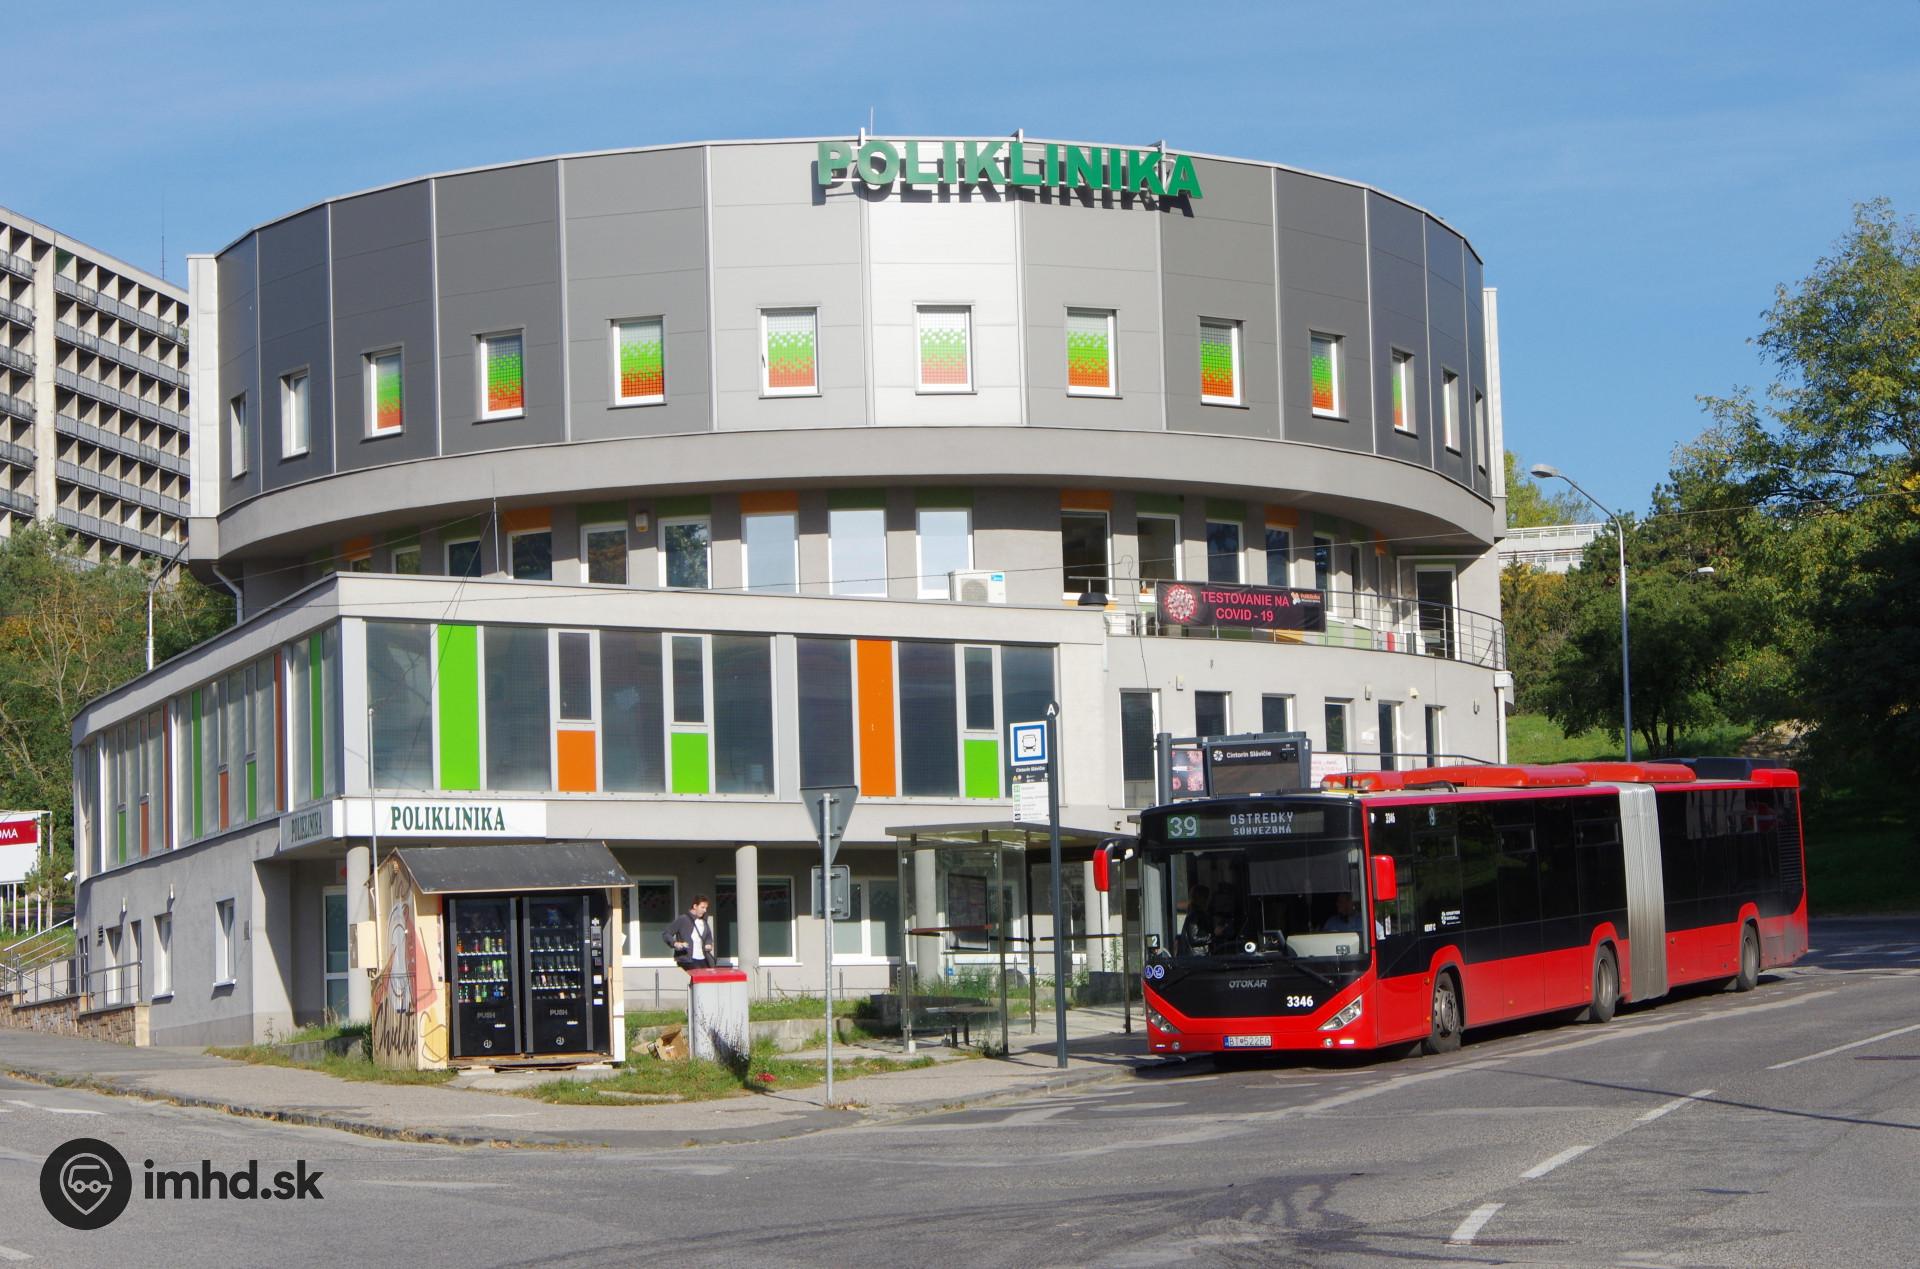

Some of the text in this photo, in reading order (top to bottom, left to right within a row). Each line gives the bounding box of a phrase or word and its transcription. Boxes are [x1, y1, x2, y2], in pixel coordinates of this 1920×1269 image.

[817, 140, 1203, 199] POLIKLINIKA
[1201, 591, 1289, 607] TESTOVANIE NA
[1216, 607, 1252, 621] COVID
[1260, 610, 1274, 622] 19
[1046, 704, 1056, 716] A
[391, 805, 506, 831] POLIKLINIKA
[1230, 811, 1294, 825] OSTREDKY
[1169, 815, 1197, 837] 39
[0, 828, 19, 839] MA
[1228, 979, 1268, 989] OTOKAR
[1286, 995, 1314, 1008] 3346
[476, 1011, 496, 1019] PUSH
[549, 1008, 568, 1016] PUSH
